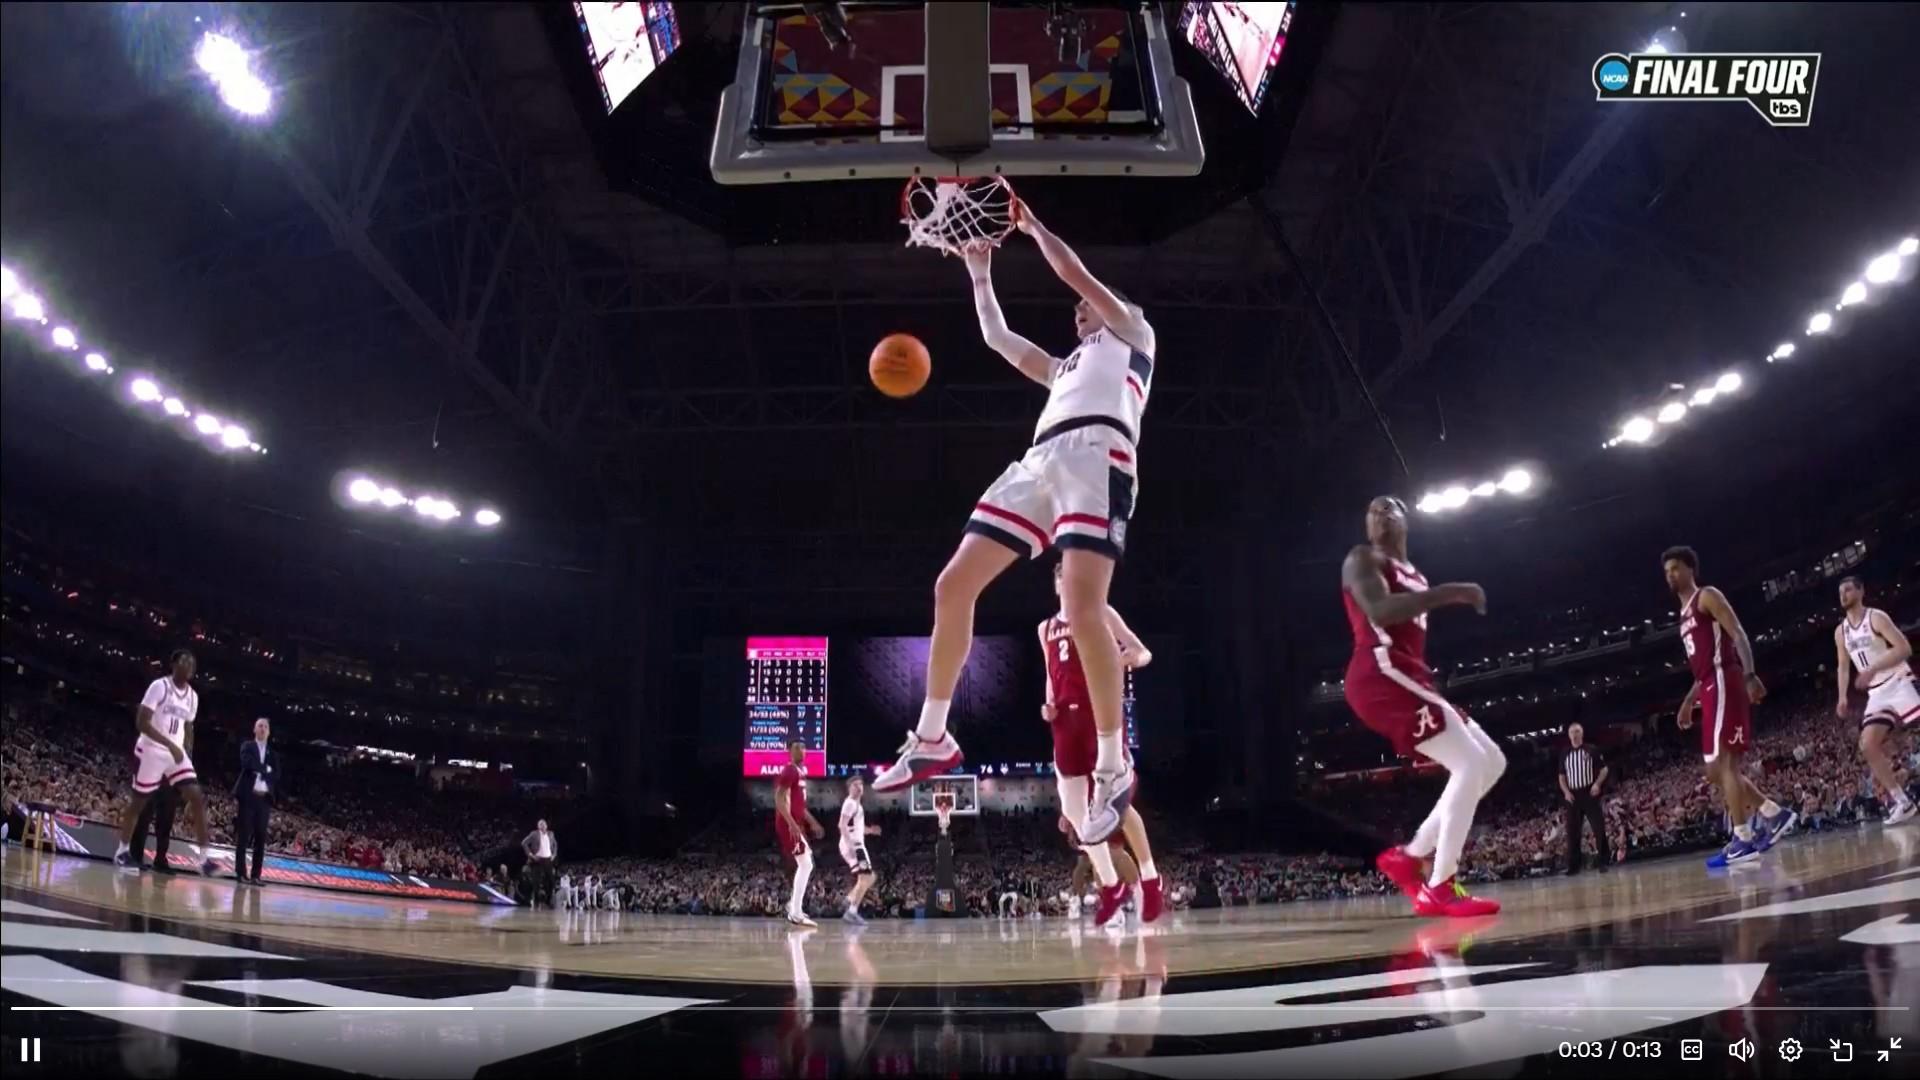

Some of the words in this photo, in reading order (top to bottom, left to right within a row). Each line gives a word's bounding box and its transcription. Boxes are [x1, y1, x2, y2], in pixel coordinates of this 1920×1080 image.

[1058, 639, 1070, 661] 2
[1858, 650, 1869, 669] 11
[761, 764, 809, 775] ALAA
[980, 764, 994, 774] 76
